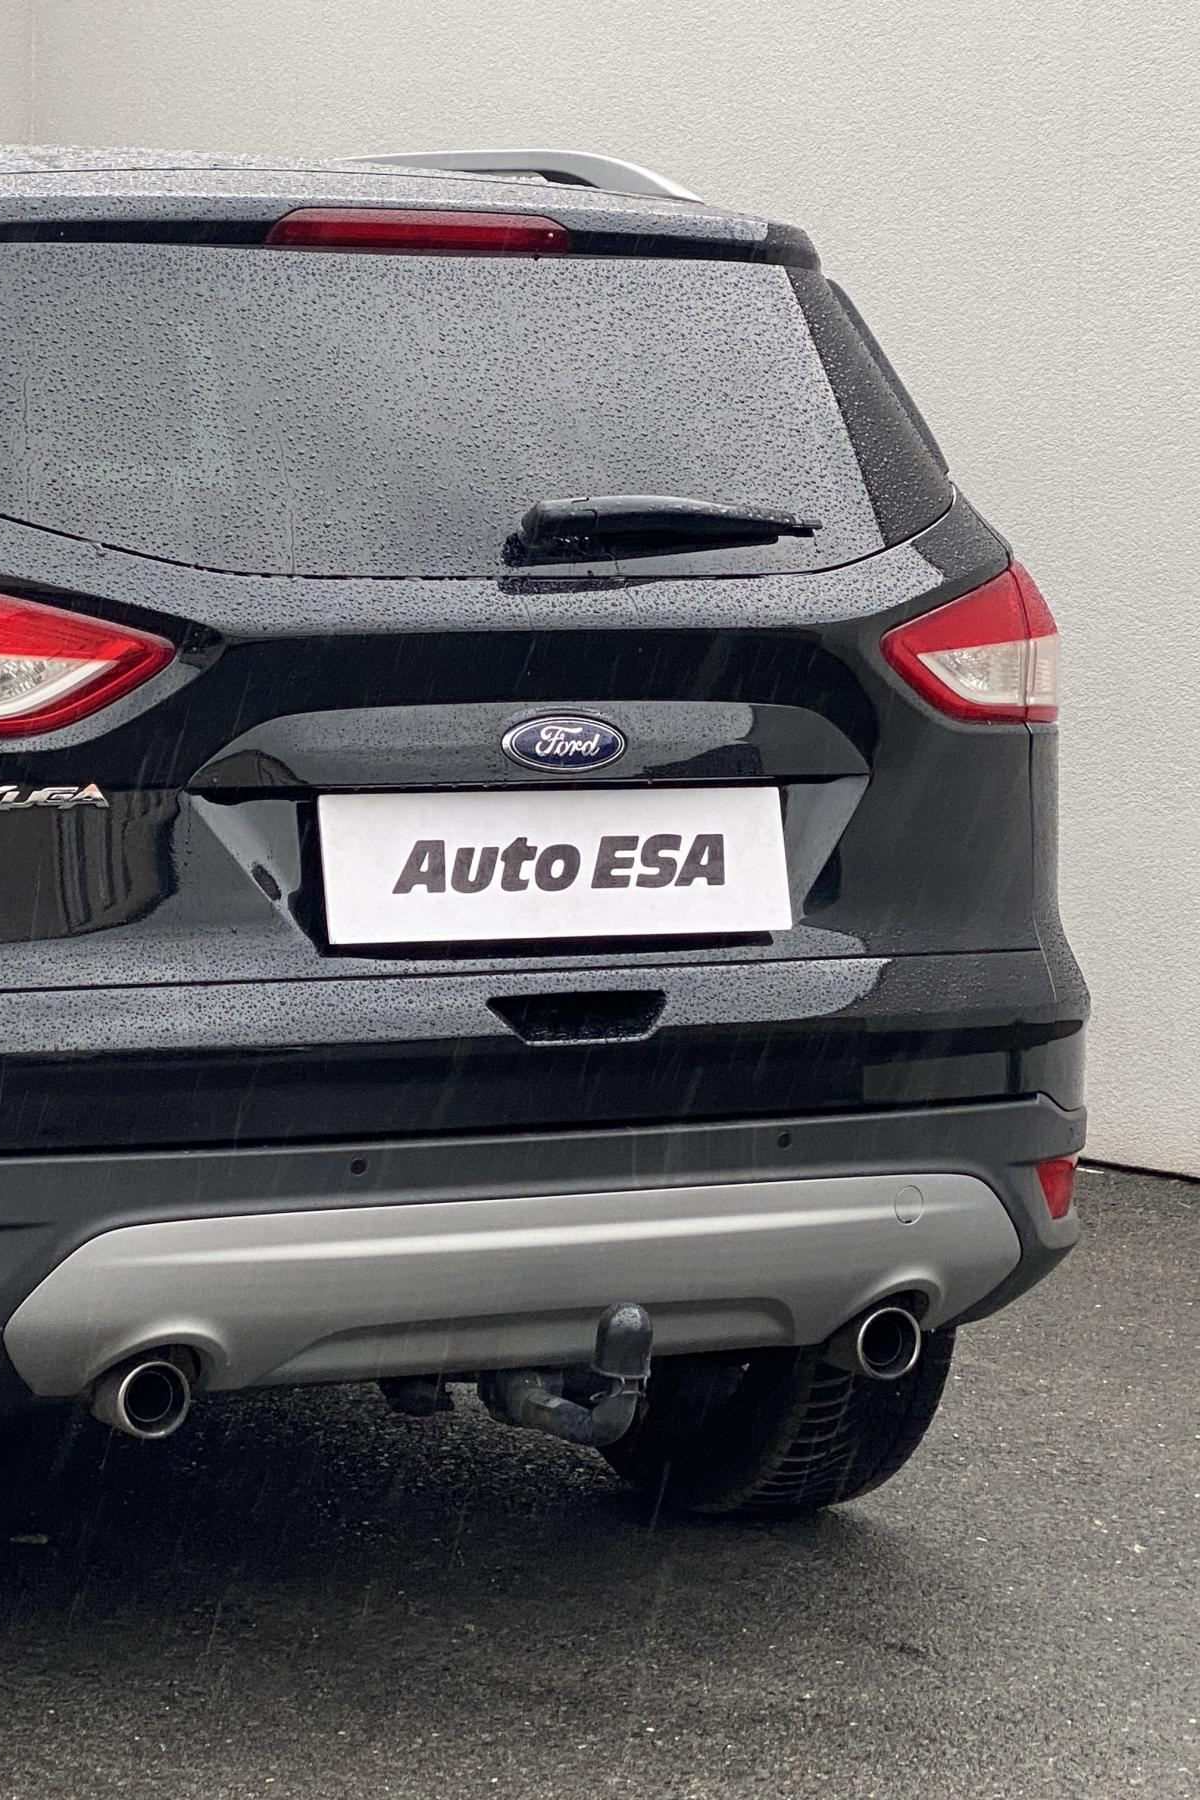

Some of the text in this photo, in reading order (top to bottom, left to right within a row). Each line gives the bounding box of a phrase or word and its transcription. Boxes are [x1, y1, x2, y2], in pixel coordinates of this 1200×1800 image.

[535, 725, 601, 757] Ford
[392, 834, 726, 894] Auto ESA
